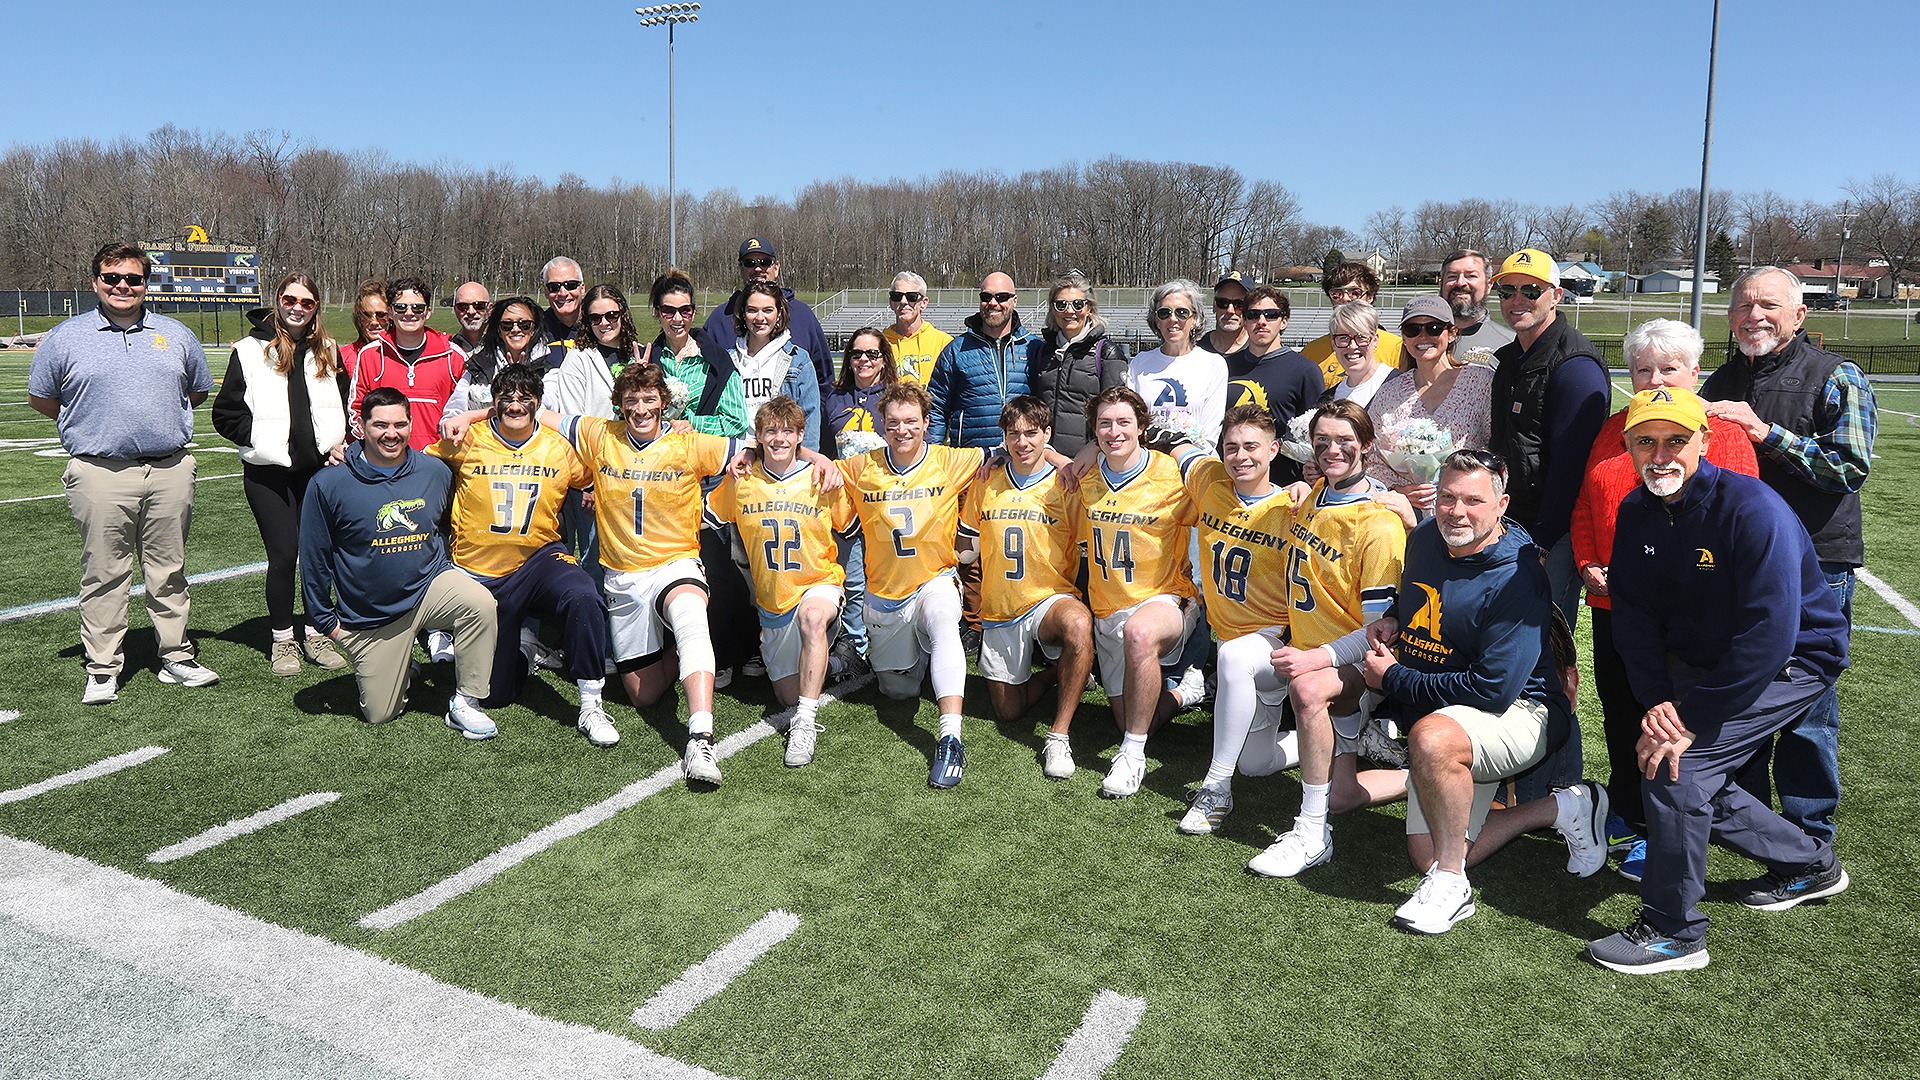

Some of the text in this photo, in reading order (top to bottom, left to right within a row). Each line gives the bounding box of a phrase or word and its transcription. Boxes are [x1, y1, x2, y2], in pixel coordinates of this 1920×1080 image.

[241, 286, 252, 294] QTR
[743, 378, 772, 399] TOR
[471, 464, 560, 479] ALLEGHENY
[599, 464, 686, 482] ALLEGHENY
[862, 485, 945, 503] ALLEGHENY
[489, 481, 540, 536] 37
[630, 486, 645, 537] 1
[742, 500, 823, 519] ALLEGHENY
[980, 508, 1059, 526] ALLEGHENY
[1085, 508, 1160, 525] LEGHENY
[371, 532, 430, 547] ALLEGHENY
[887, 505, 917, 559] 2
[1200, 512, 1288, 551] ALLEGHENY
[1289, 521, 1344, 563] LEGHENY
[381, 543, 423, 554] LACROSSE
[760, 517, 802, 573] 22
[1003, 525, 1026, 581] 9
[1092, 525, 1136, 584] 44
[1211, 539, 1252, 603] 18
